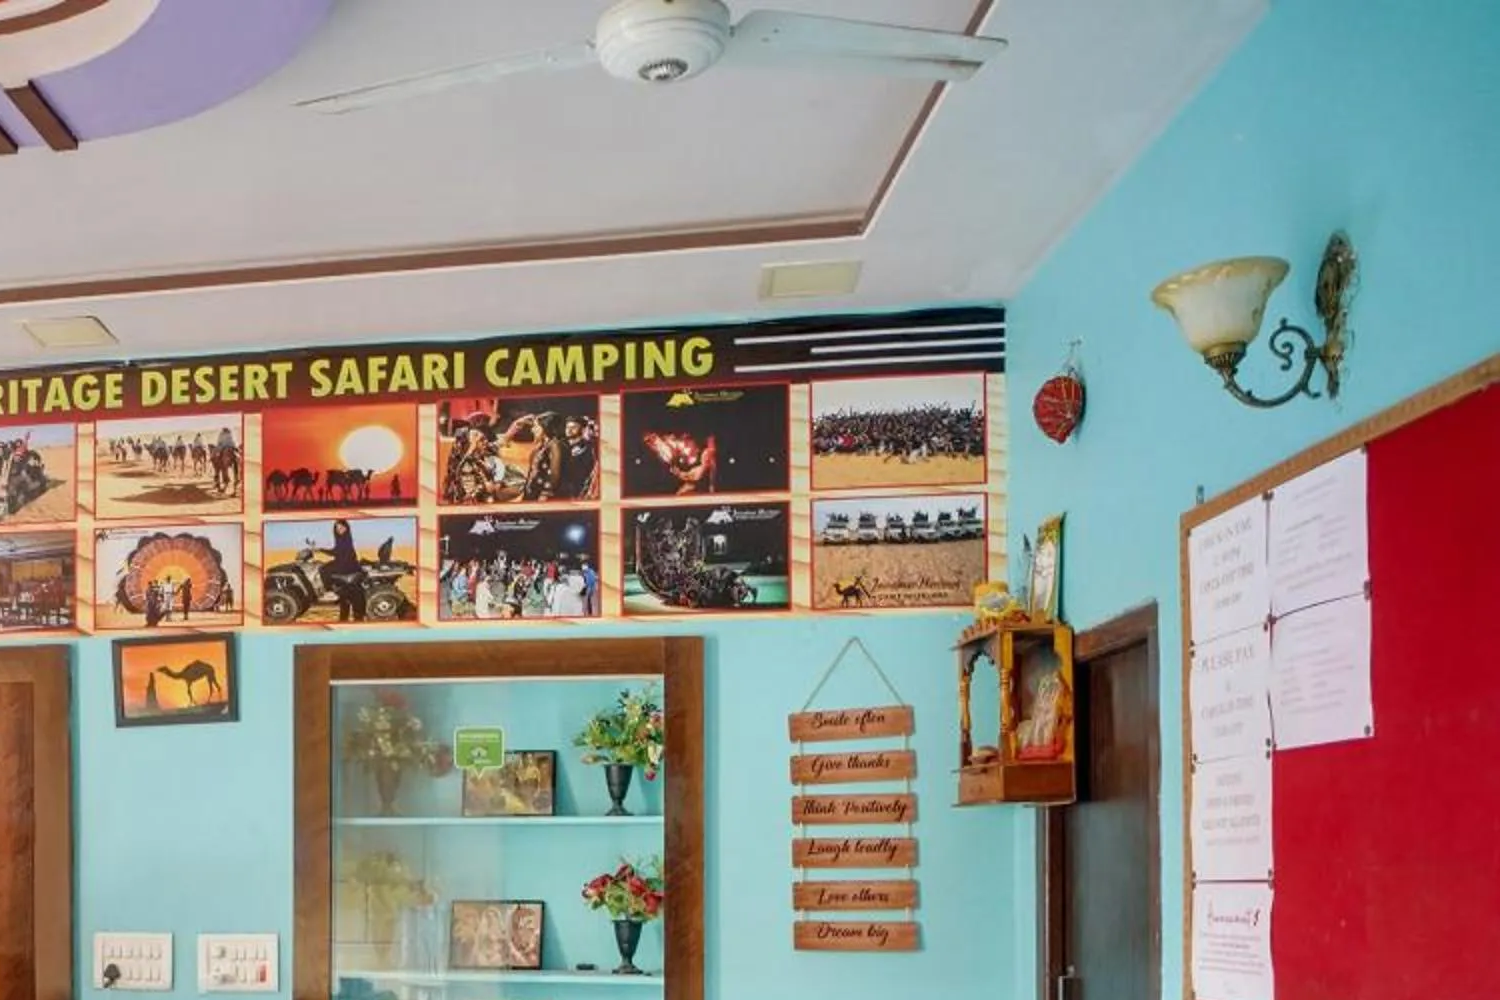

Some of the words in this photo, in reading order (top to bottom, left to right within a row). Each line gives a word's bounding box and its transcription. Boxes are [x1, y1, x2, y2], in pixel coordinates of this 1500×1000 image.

[141, 361, 293, 408] DESERT
[310, 352, 465, 397] SAFARI
[485, 337, 714, 387] CAMPING
[811, 756, 843, 778] Give
[847, 752, 890, 769] thanks
[808, 838, 851, 862] Laugh
[854, 838, 899, 862] loudly
[818, 887, 848, 905] Love
[817, 921, 862, 939] Dream
[867, 923, 889, 947] big
